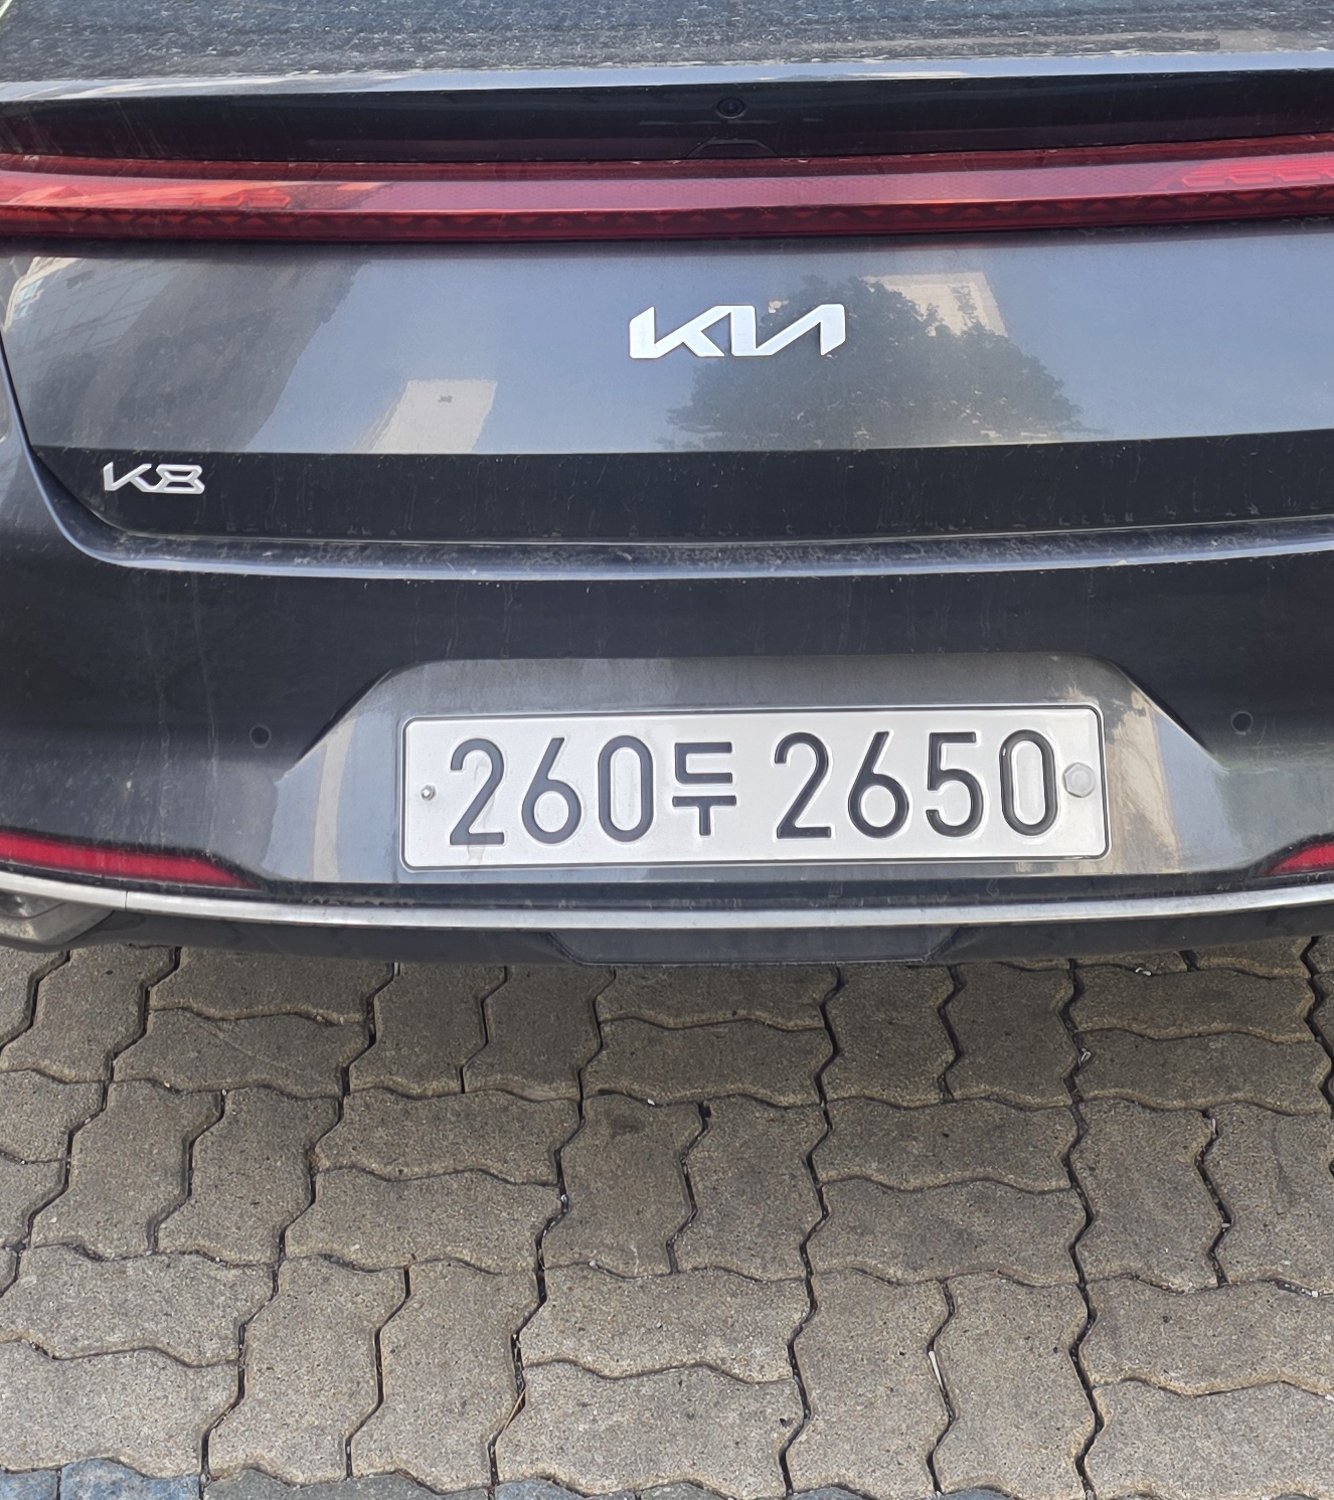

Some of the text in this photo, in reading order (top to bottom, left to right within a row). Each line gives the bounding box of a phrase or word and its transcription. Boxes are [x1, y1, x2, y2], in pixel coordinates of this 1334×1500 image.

[628, 303, 846, 360] KIA
[102, 461, 206, 495] K8
[448, 728, 1060, 847] 260두 2650
